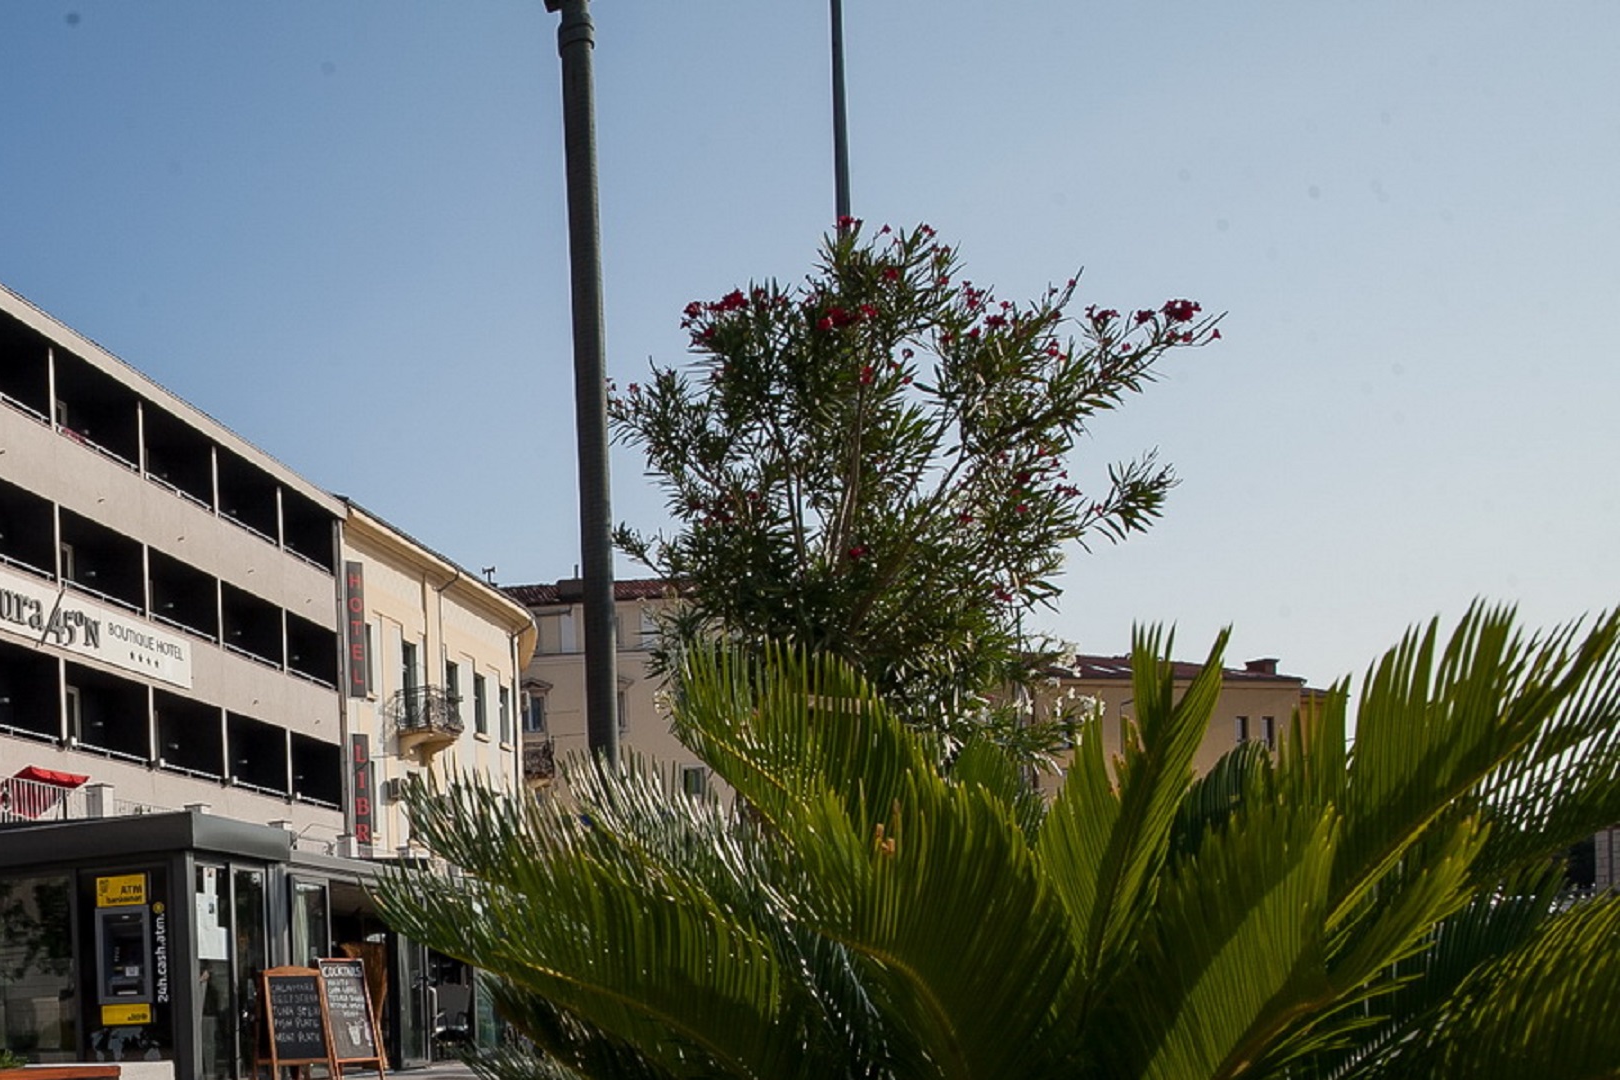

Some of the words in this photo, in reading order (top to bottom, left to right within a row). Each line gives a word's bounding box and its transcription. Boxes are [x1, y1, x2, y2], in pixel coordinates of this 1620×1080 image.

[108, 621, 155, 650] BOUTIQUE
[155, 640, 185, 662] HOTEL
[347, 574, 364, 685] HOTEL
[120, 884, 143, 895] ATM
